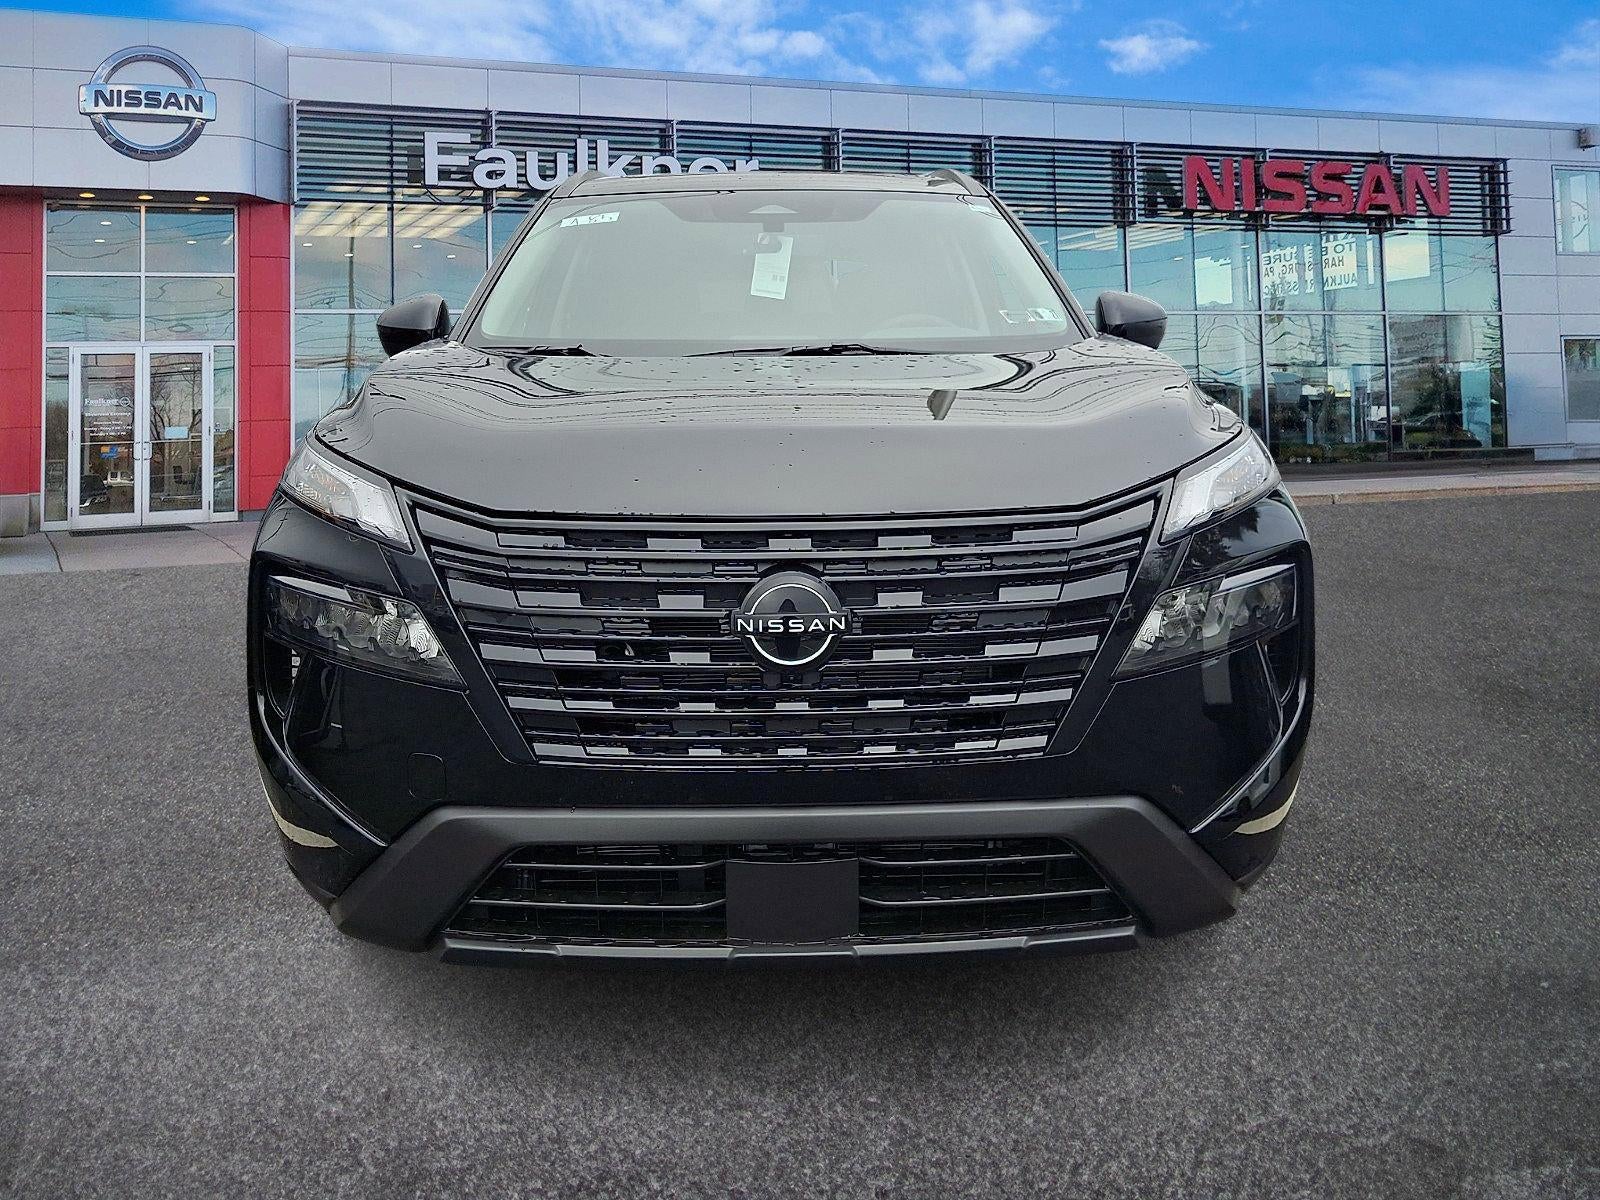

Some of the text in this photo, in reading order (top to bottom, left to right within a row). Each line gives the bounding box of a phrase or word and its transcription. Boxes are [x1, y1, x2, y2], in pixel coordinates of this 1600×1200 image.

[94, 89, 203, 113] NISSAN
[1182, 155, 1451, 216] NISSAN
[737, 616, 846, 633] NISSAN
